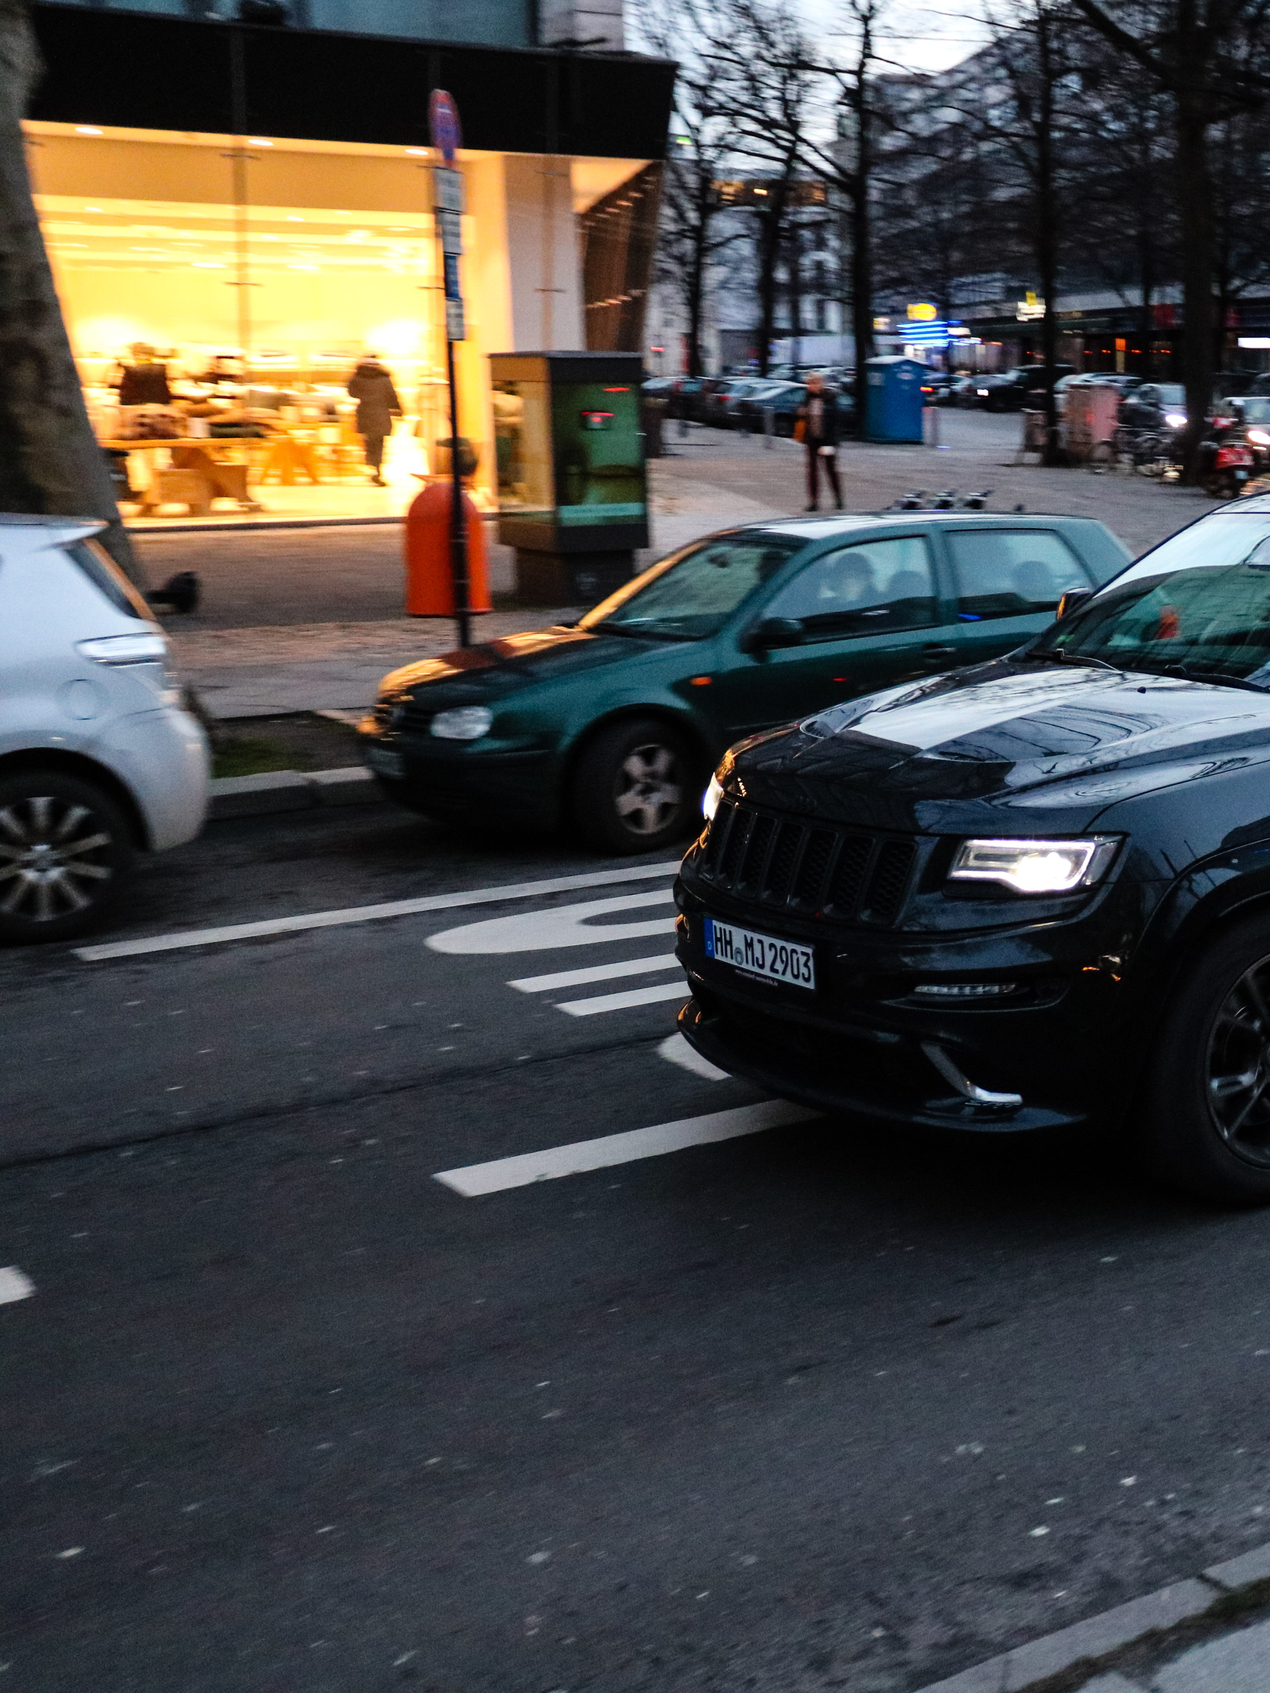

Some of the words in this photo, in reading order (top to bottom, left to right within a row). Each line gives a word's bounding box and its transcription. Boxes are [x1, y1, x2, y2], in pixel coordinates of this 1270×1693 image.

[713, 925, 734, 960] HH
[744, 934, 766, 970] MJ
[768, 942, 812, 983] 2903
